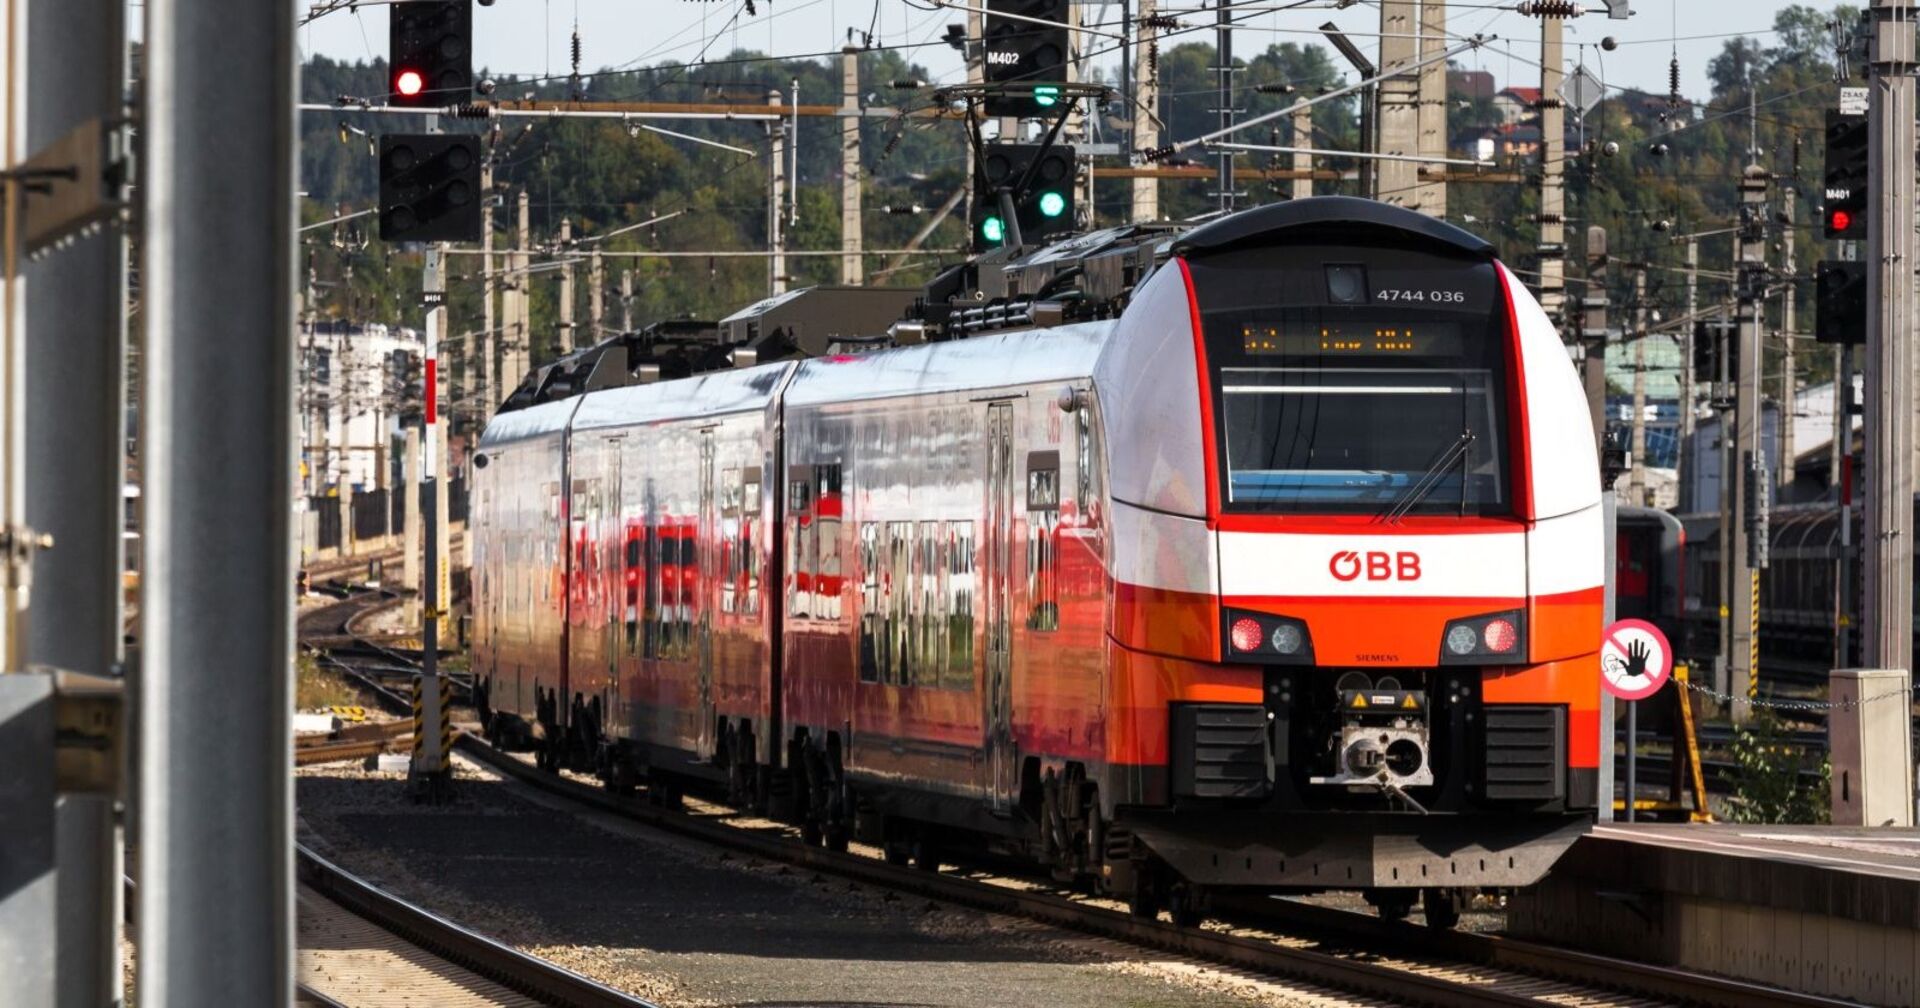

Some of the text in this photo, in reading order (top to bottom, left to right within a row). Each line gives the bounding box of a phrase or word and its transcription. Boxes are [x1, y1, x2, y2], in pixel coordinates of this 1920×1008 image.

[988, 51, 1019, 64] M402
[1826, 189, 1850, 199] M401
[1377, 289, 1464, 302] 4744 036
[1329, 551, 1422, 581] ÖBB
[1355, 654, 1399, 662] SIEMENS
